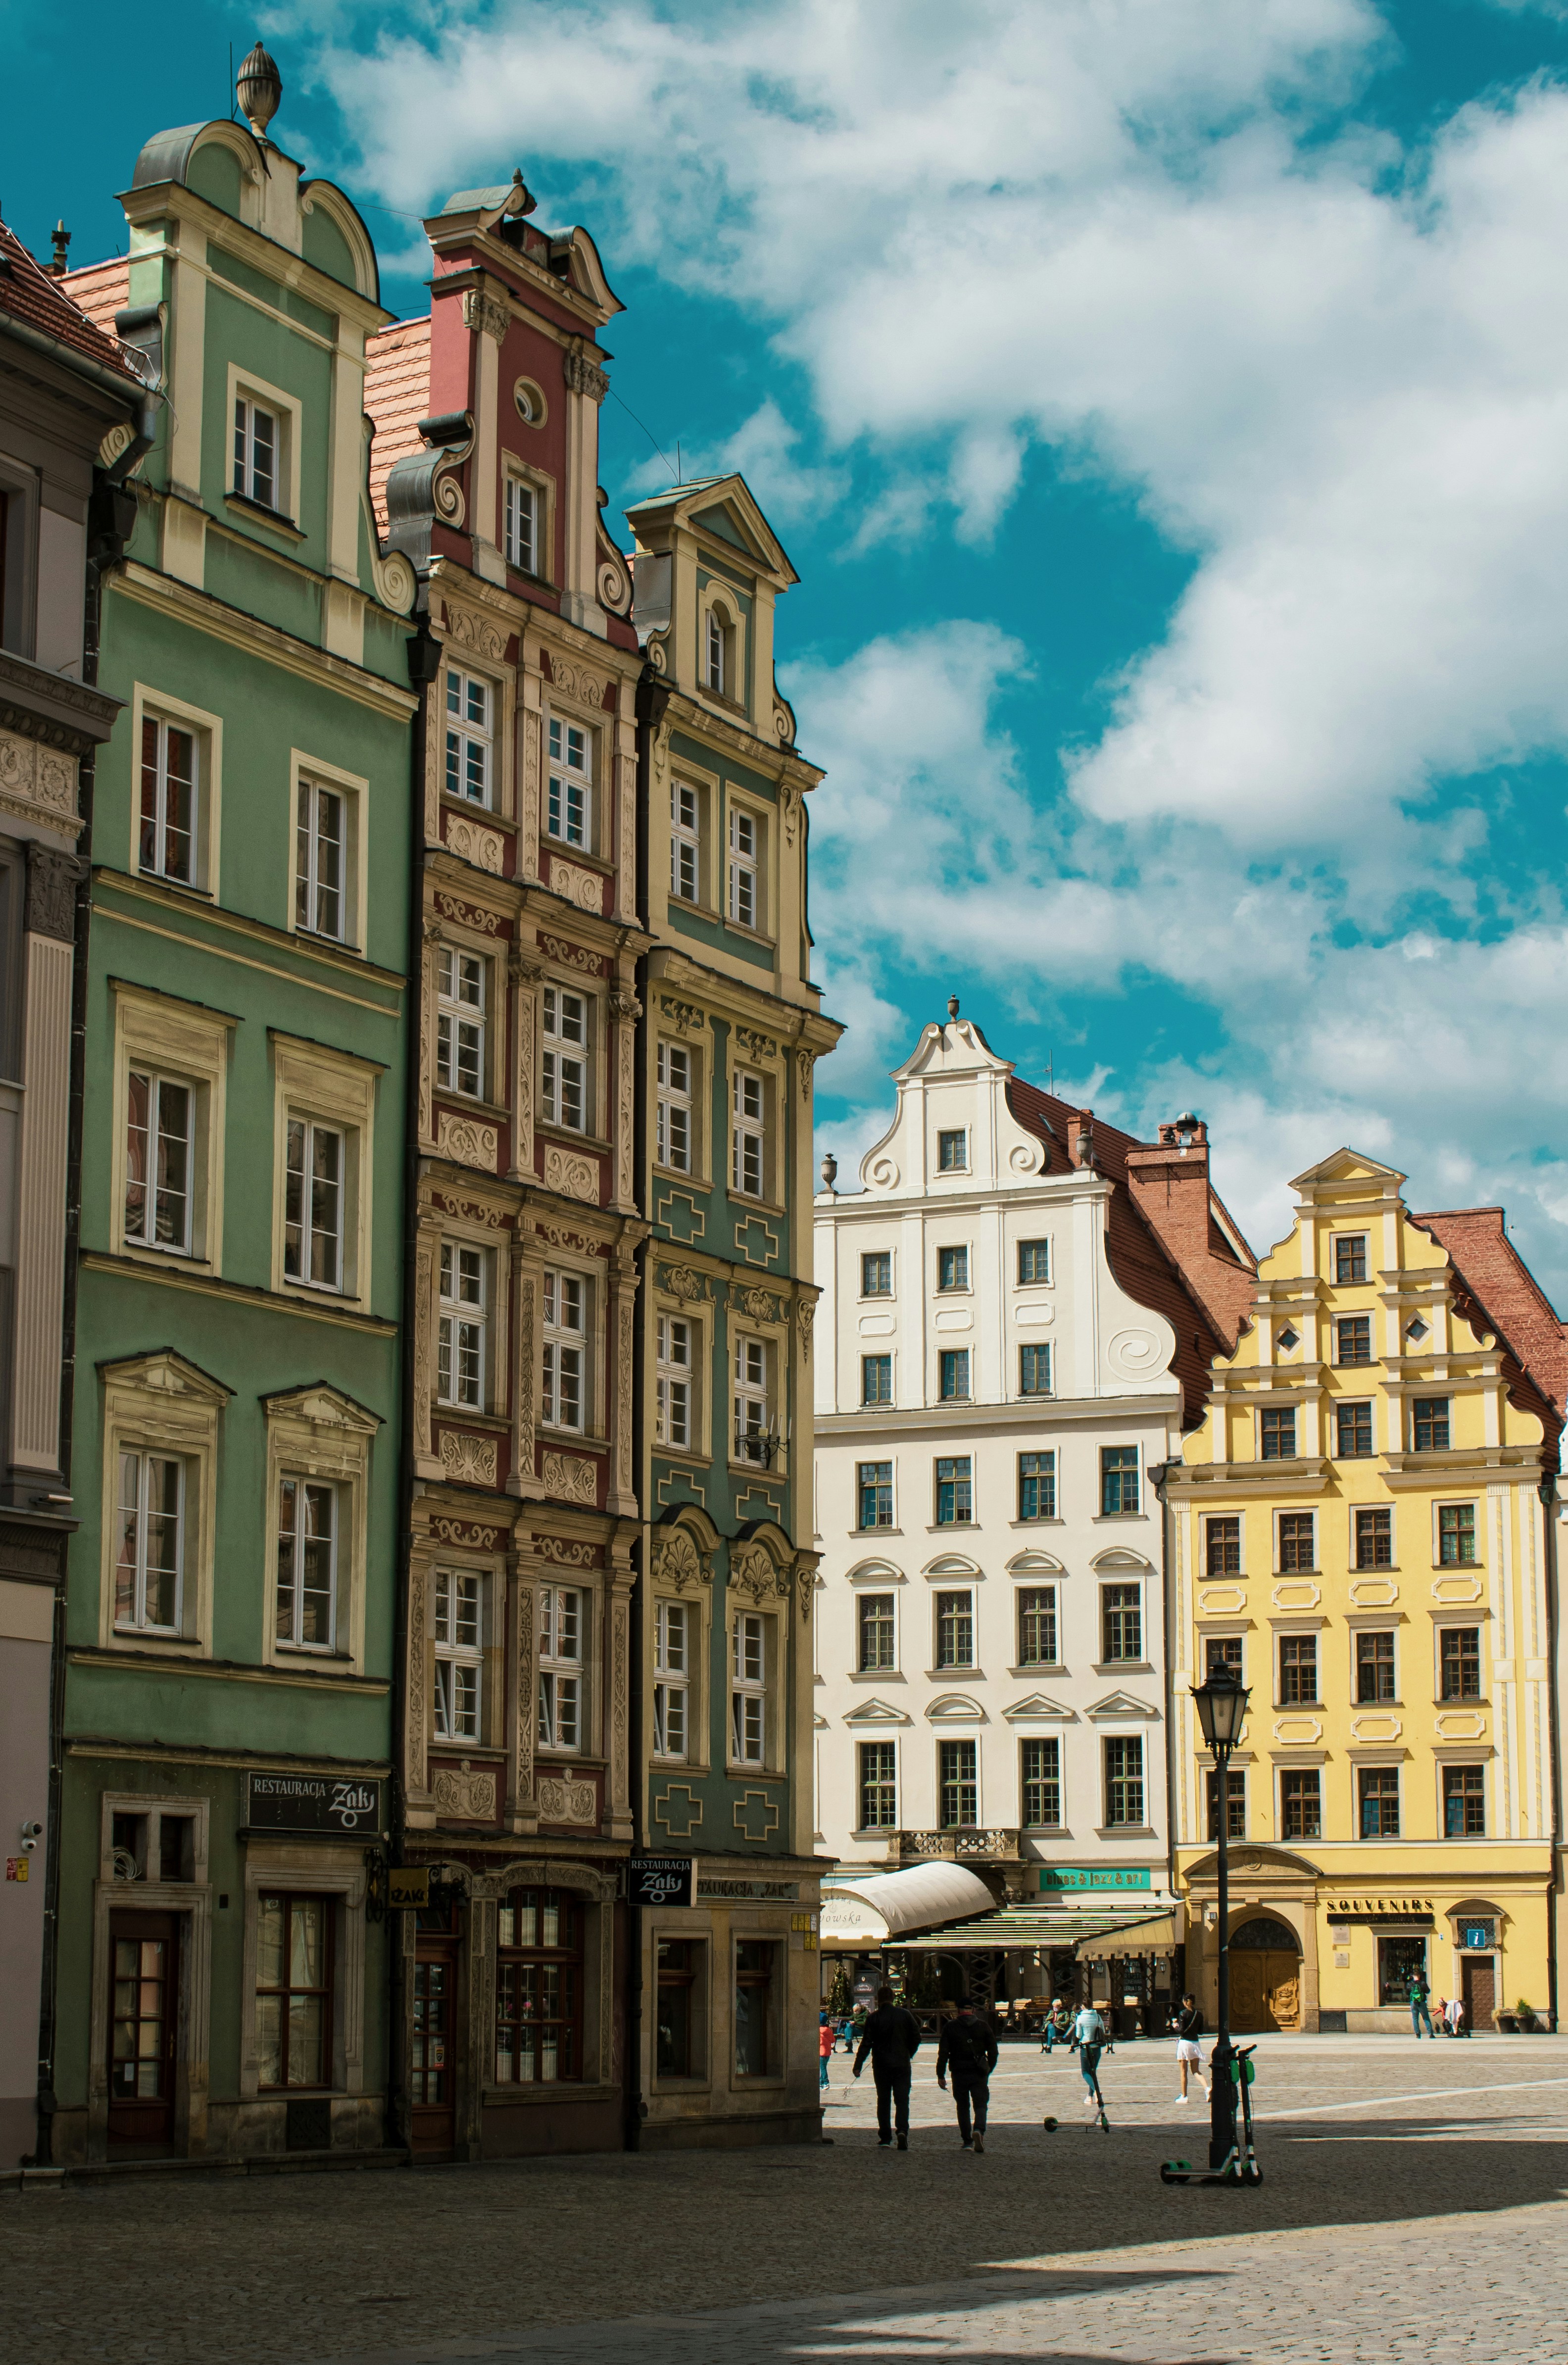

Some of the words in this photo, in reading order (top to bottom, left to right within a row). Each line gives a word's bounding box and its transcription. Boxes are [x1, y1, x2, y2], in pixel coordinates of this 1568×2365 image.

[254, 1778, 326, 1798] RESTAURACJA
[631, 1860, 690, 1872] RESTAURACJA
[1046, 1872, 1075, 1885] blues
[1078, 1872, 1086, 1885] &
[1090, 1872, 1112, 1886] jazz
[1115, 1872, 1123, 1884] &
[1126, 1872, 1143, 1884] art
[1327, 1899, 1434, 1911] SOUVENIRS
